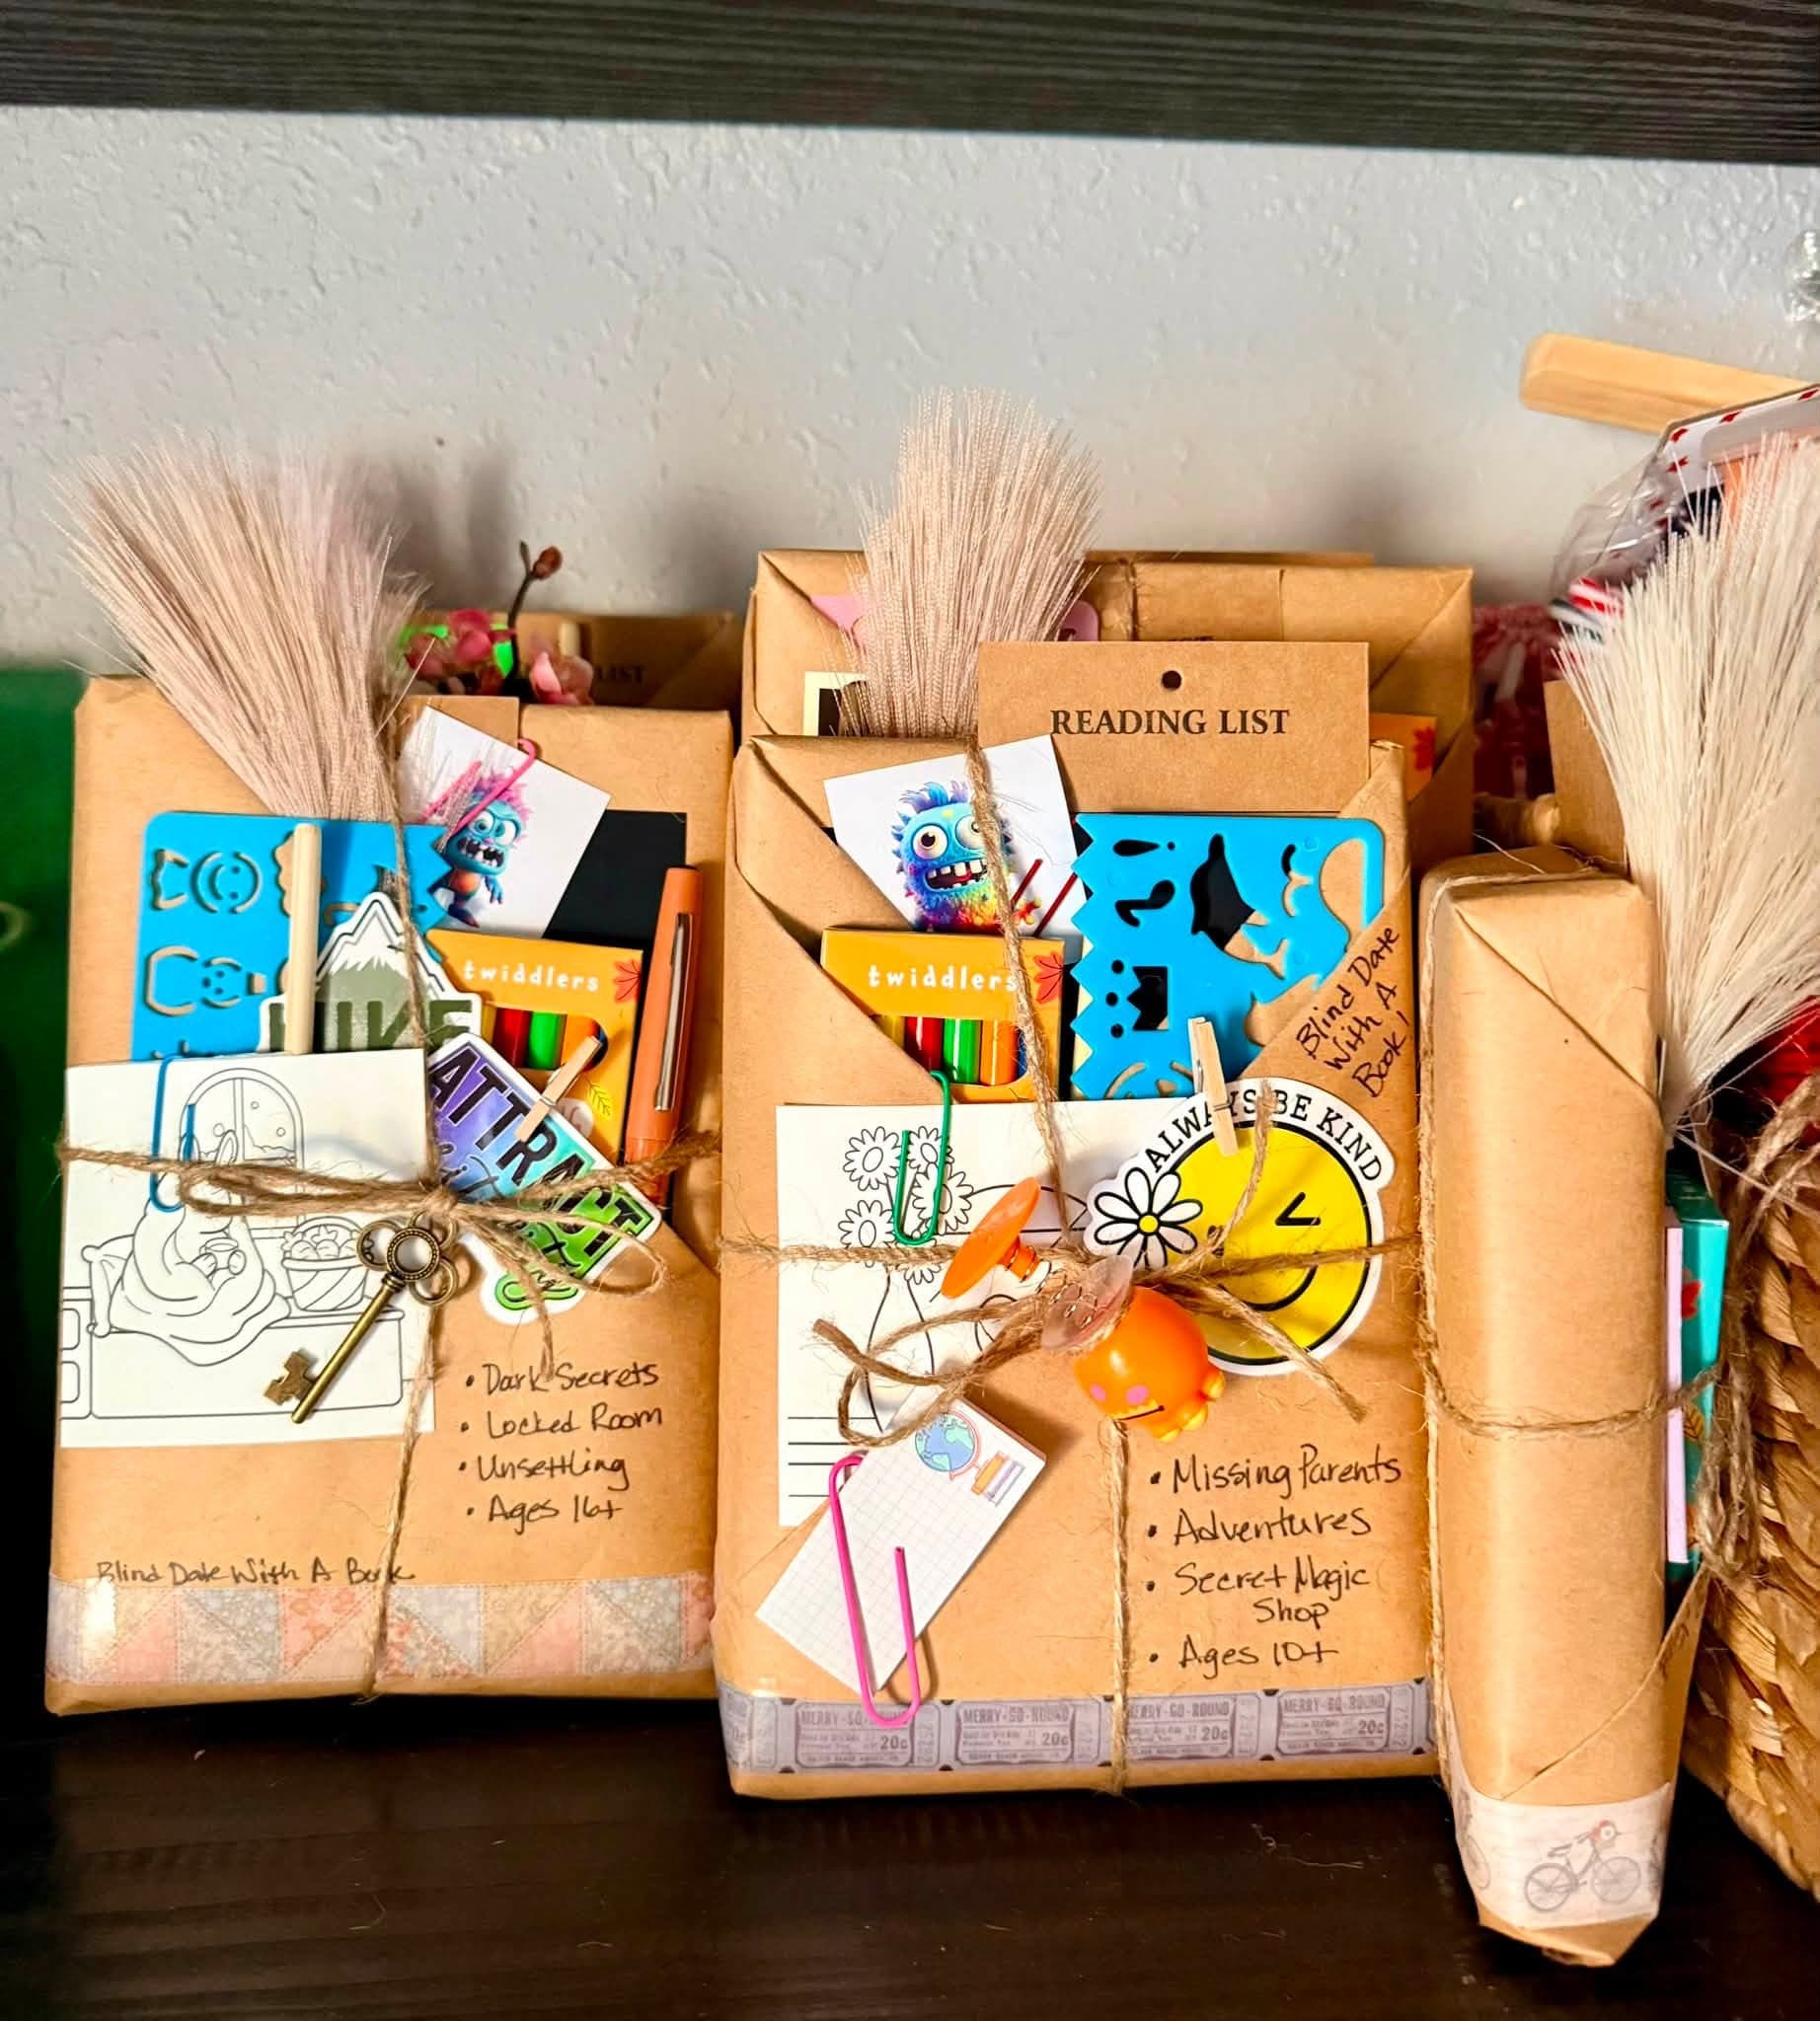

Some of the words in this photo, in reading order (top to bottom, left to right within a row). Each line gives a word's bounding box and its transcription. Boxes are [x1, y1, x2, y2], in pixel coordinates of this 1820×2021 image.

[1050, 710, 1206, 734] READING
[1219, 710, 1289, 734] LIST
[463, 959, 600, 992] twiddlers
[869, 964, 1018, 992] twiddlers
[1296, 984, 1354, 1060] Blind
[1347, 928, 1400, 987] Date
[1324, 1016, 1382, 1070] With
[1376, 981, 1397, 1010] A
[1274, 1089, 1312, 1121] BE
[1317, 1107, 1382, 1181] KIND
[482, 1364, 549, 1394] Dark
[555, 1362, 658, 1389] Secrets
[488, 1410, 580, 1438] Locked
[592, 1402, 662, 1431] Room
[478, 1448, 630, 1491] Unsettling
[1173, 1454, 1291, 1499] Missing
[1299, 1443, 1402, 1489] Parents
[489, 1494, 560, 1534] Ages
[573, 1494, 623, 1523] 16+
[1175, 1506, 1371, 1545] Adventures
[97, 1560, 162, 1583] Blind
[168, 1561, 229, 1586] Date
[230, 1557, 300, 1584] With
[311, 1556, 339, 1583] A
[1175, 1562, 1287, 1596] Secret
[1295, 1555, 1370, 1601] Magic
[1252, 1597, 1328, 1629] Shop
[1178, 1633, 1259, 1680] Ages
[1273, 1641, 1338, 1667] 10+
